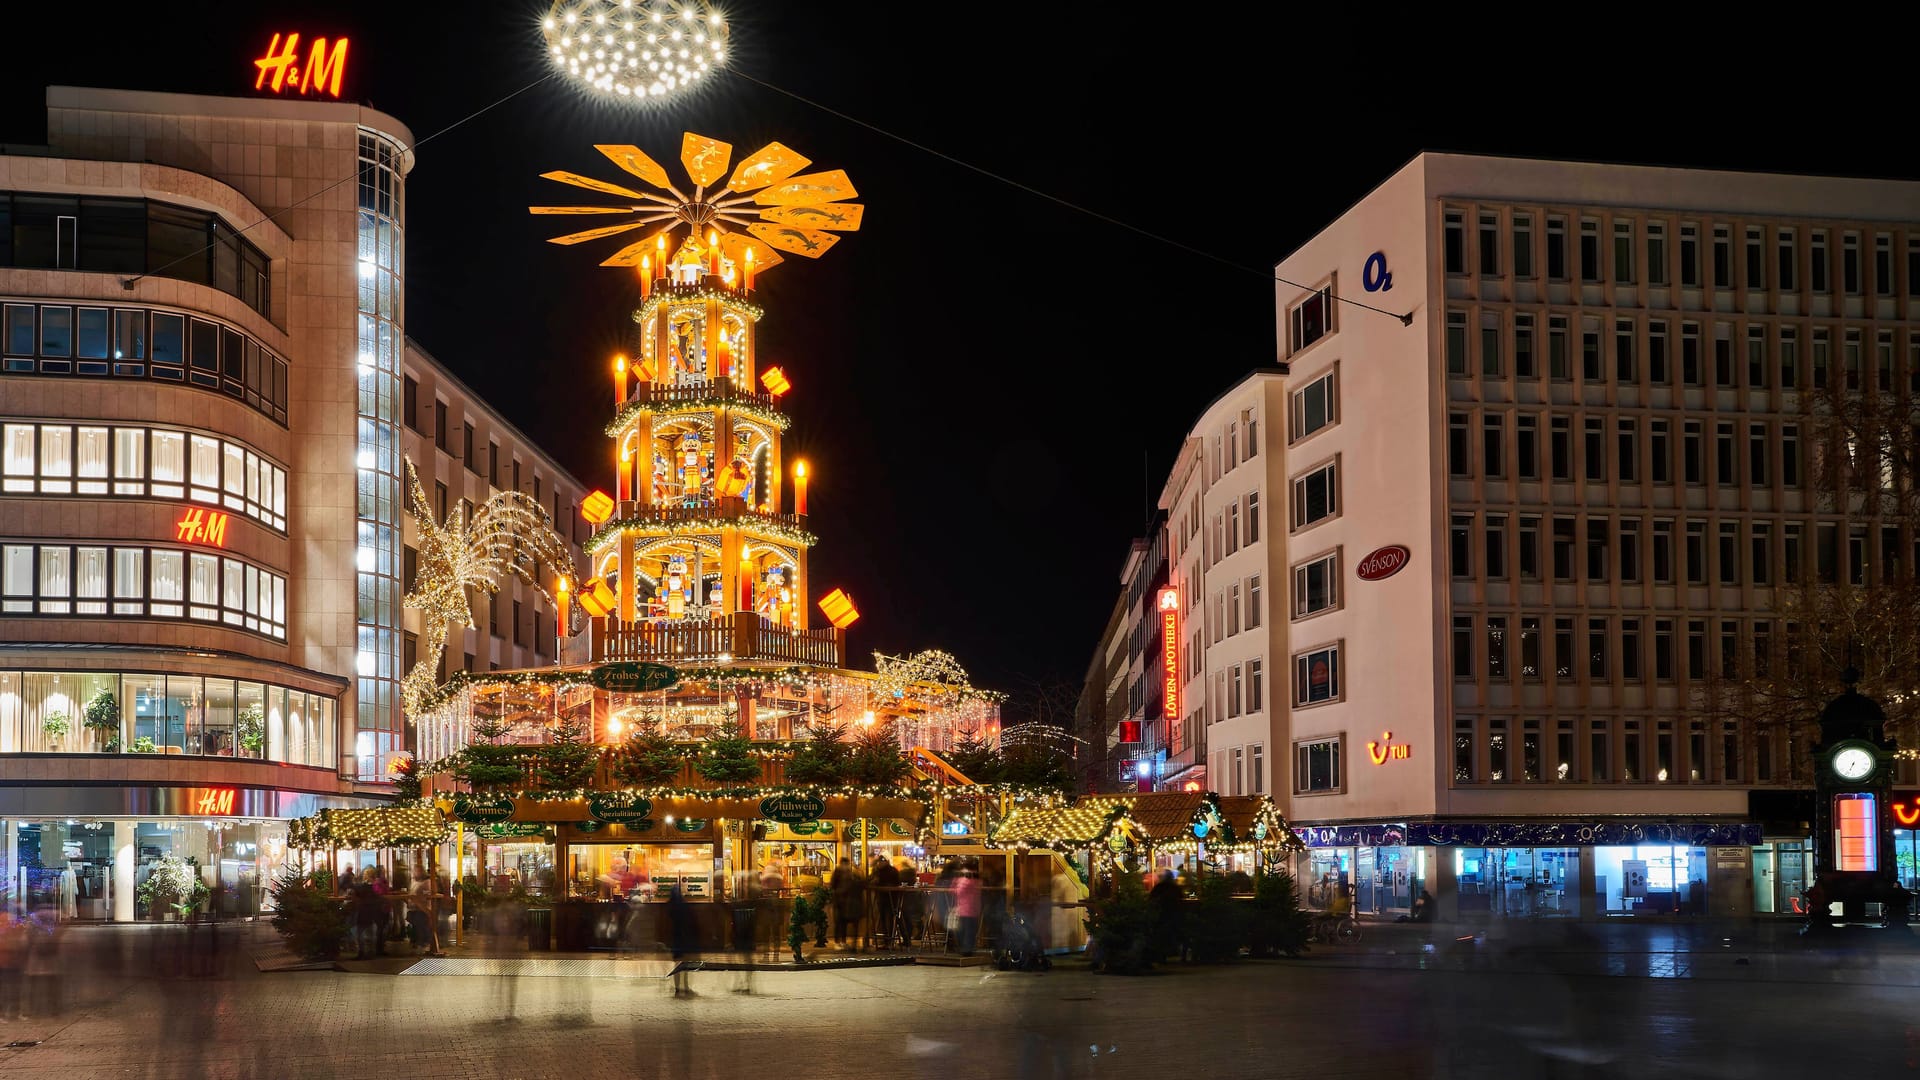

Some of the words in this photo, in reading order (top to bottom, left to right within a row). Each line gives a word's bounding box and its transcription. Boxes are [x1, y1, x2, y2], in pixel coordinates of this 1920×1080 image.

[254, 32, 348, 97] H&M
[178, 508, 227, 547] H&M
[1361, 551, 1400, 576] SVENSON
[602, 666, 640, 681] Frohes
[644, 665, 669, 681] Fest
[1166, 614, 1177, 717] LÖWEN-APOTHEKE
[1391, 744, 1408, 760] TUI
[198, 789, 235, 815] H&M
[461, 801, 508, 816] Pommes
[766, 799, 818, 813] Glühwein
[600, 810, 641, 819] Spezialitäten
